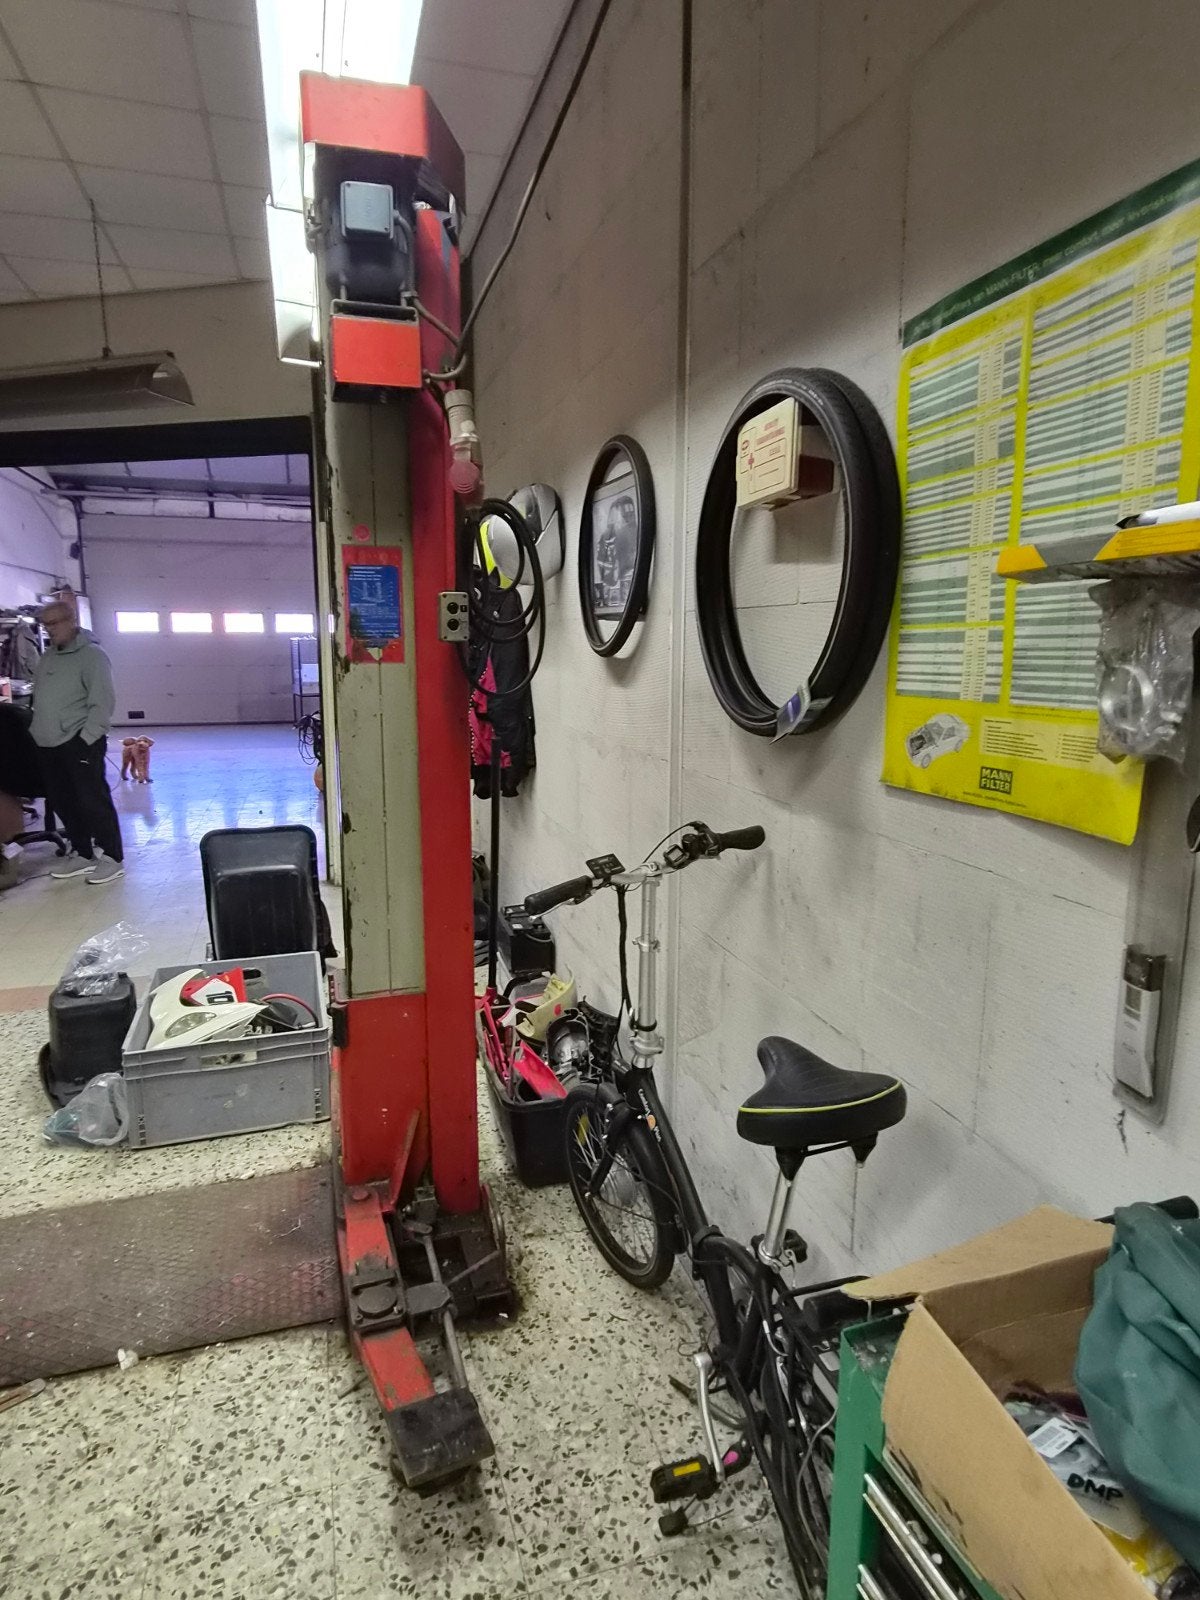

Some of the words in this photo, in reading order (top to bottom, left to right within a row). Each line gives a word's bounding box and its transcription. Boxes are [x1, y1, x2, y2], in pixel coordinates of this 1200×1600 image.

[982, 768, 1012, 782] MANN
[980, 778, 1010, 793] FILTER
[1067, 1473, 1124, 1501] DMP
